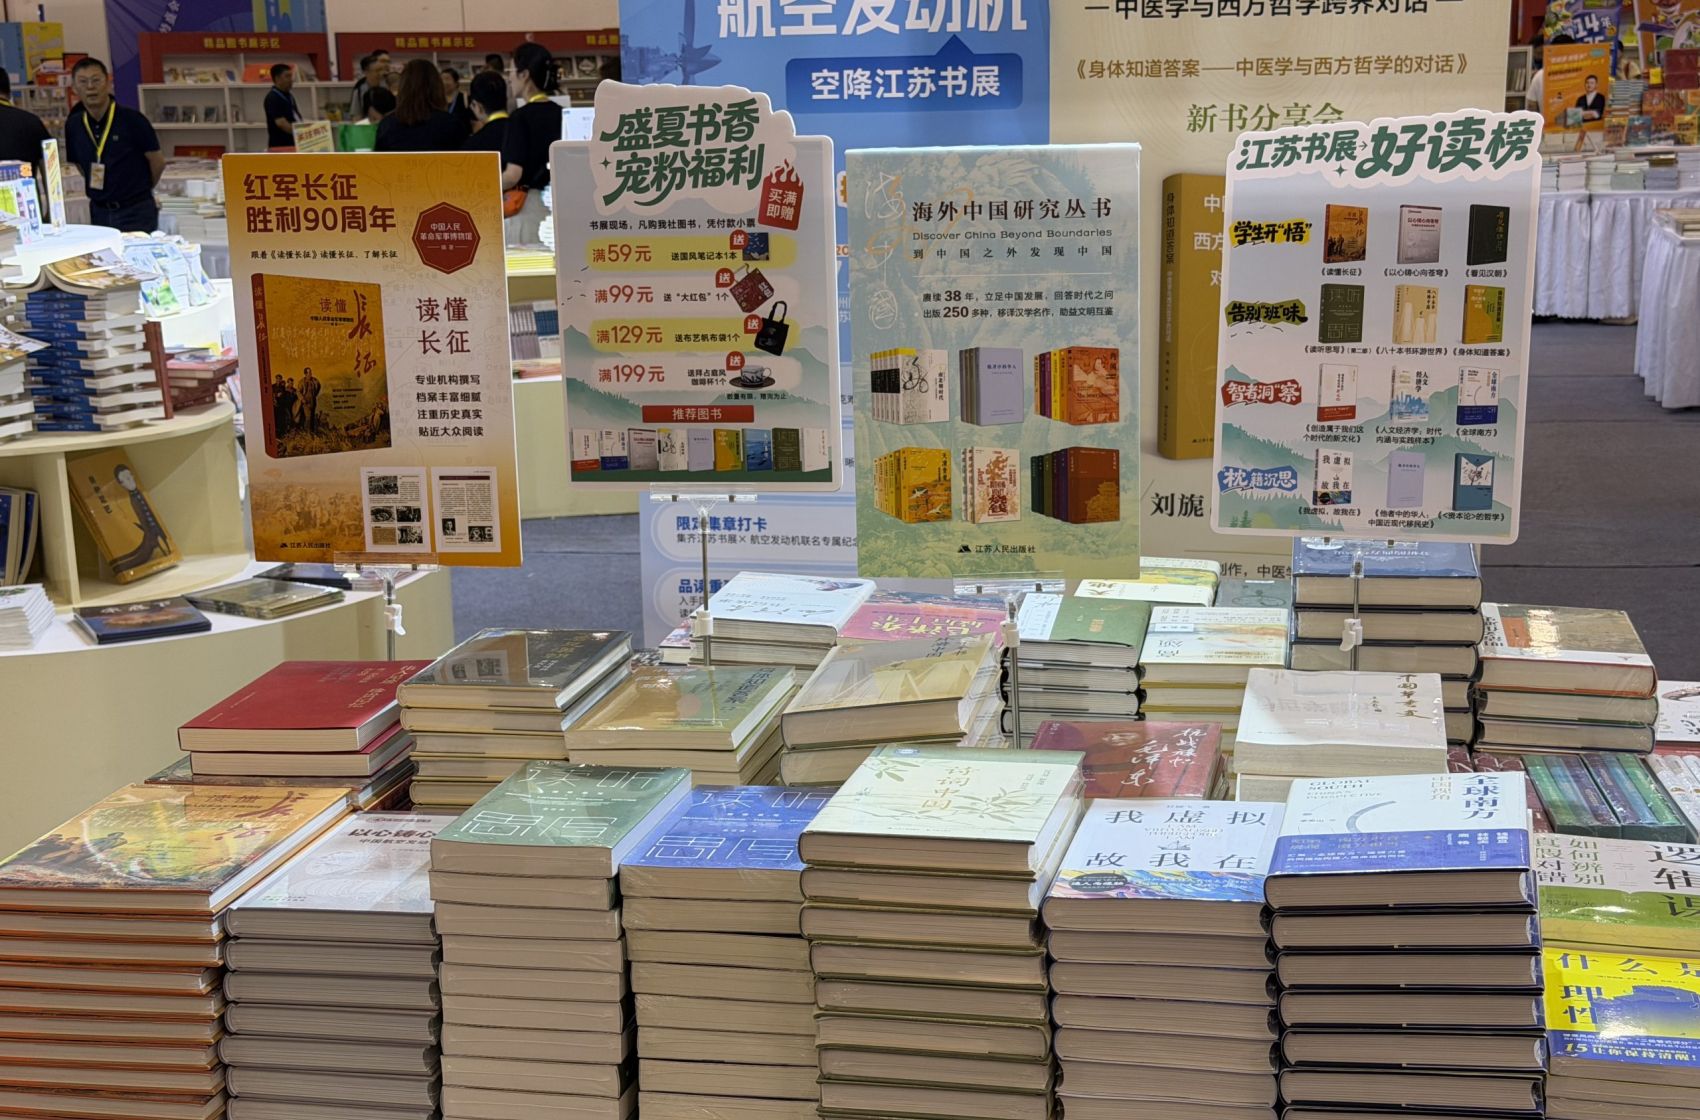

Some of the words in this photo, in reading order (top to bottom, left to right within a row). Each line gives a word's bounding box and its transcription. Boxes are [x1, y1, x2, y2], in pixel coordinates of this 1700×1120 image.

[811, 66, 1000, 100] 空降江苏书展
[600, 98, 760, 152] 盛夏书香
[1236, 129, 1359, 171] 江苏书展
[1355, 117, 1536, 179] 好读榜
[602, 144, 766, 207] 宠粉福利
[243, 173, 358, 201] 红军长征
[768, 188, 798, 206] 买满
[1204, 194, 1225, 213] 中
[766, 204, 796, 222] 即赠
[912, 197, 1112, 222] 海外中国研究丛书
[247, 205, 397, 233] 胜利90周年
[430, 222, 461, 231] 中国人民
[733, 235, 746, 246] 送
[912, 231, 961, 241] Discover
[964, 230, 996, 239] China
[1001, 230, 1043, 241] Beyond
[1047, 228, 1113, 238] Boundaries
[1194, 232, 1223, 250] 西方
[592, 243, 652, 264] 满59元
[913, 245, 1112, 259] 到中国之外发现中国
[718, 272, 732, 283] 送
[594, 285, 654, 304] 满99元
[320, 298, 347, 313] 读懂
[415, 297, 469, 322] 读懂
[747, 319, 759, 330] 送
[418, 329, 471, 354] 长征
[596, 325, 663, 344] 满129元
[730, 356, 742, 366] 送
[415, 374, 481, 386] 专业机构撰写
[598, 364, 665, 383] 满199元
[416, 391, 482, 403] 档案丰富细腻
[417, 409, 483, 420] 注重历史真实
[672, 408, 723, 421] 推荐图书
[418, 426, 484, 437] 贴近大众阅读
[676, 516, 768, 532] 限定集章打卡
[975, 544, 1036, 554] 江苏人民出版社
[1461, 774, 1500, 820] 全球南方
[1105, 809, 1267, 826] 我虚拟
[1086, 852, 1258, 869] 故我在
[1569, 838, 1605, 886] 如何辨别
